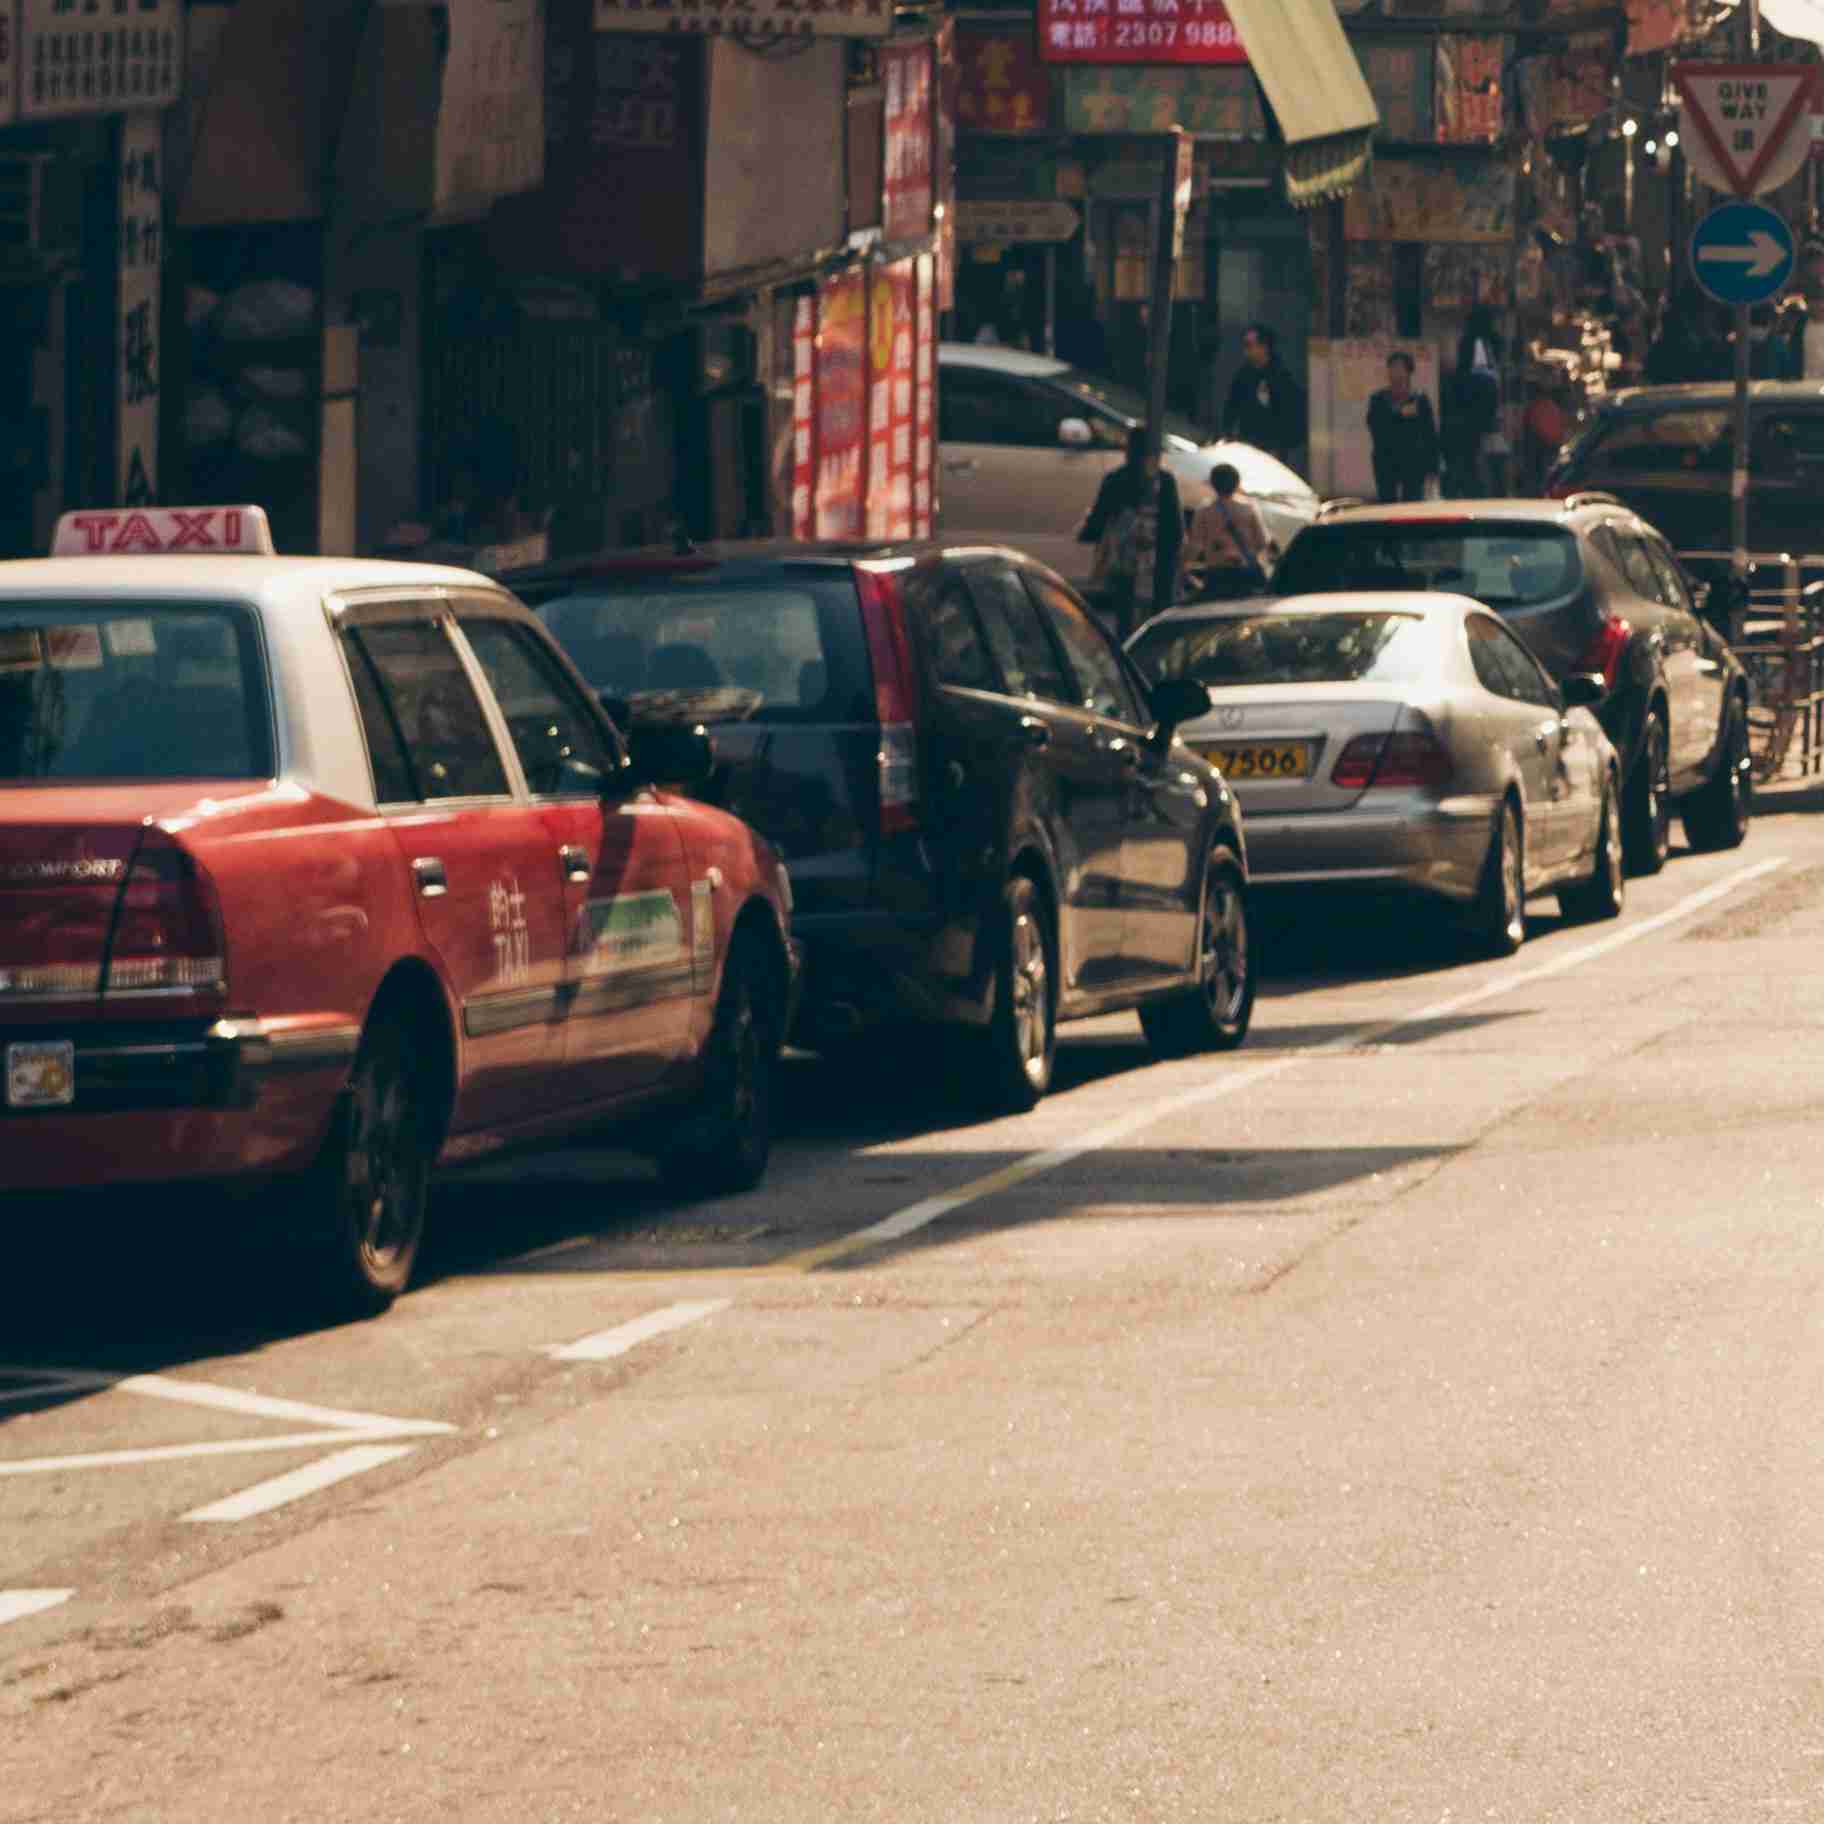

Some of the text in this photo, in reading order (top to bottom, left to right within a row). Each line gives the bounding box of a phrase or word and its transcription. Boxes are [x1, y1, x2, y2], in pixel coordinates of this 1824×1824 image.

[1116, 24, 1177, 46] 2307
[1717, 80, 1768, 98] GIVE
[1720, 104, 1767, 120] WAY
[72, 509, 243, 551] TAXI
[494, 929, 529, 984] TAXI
